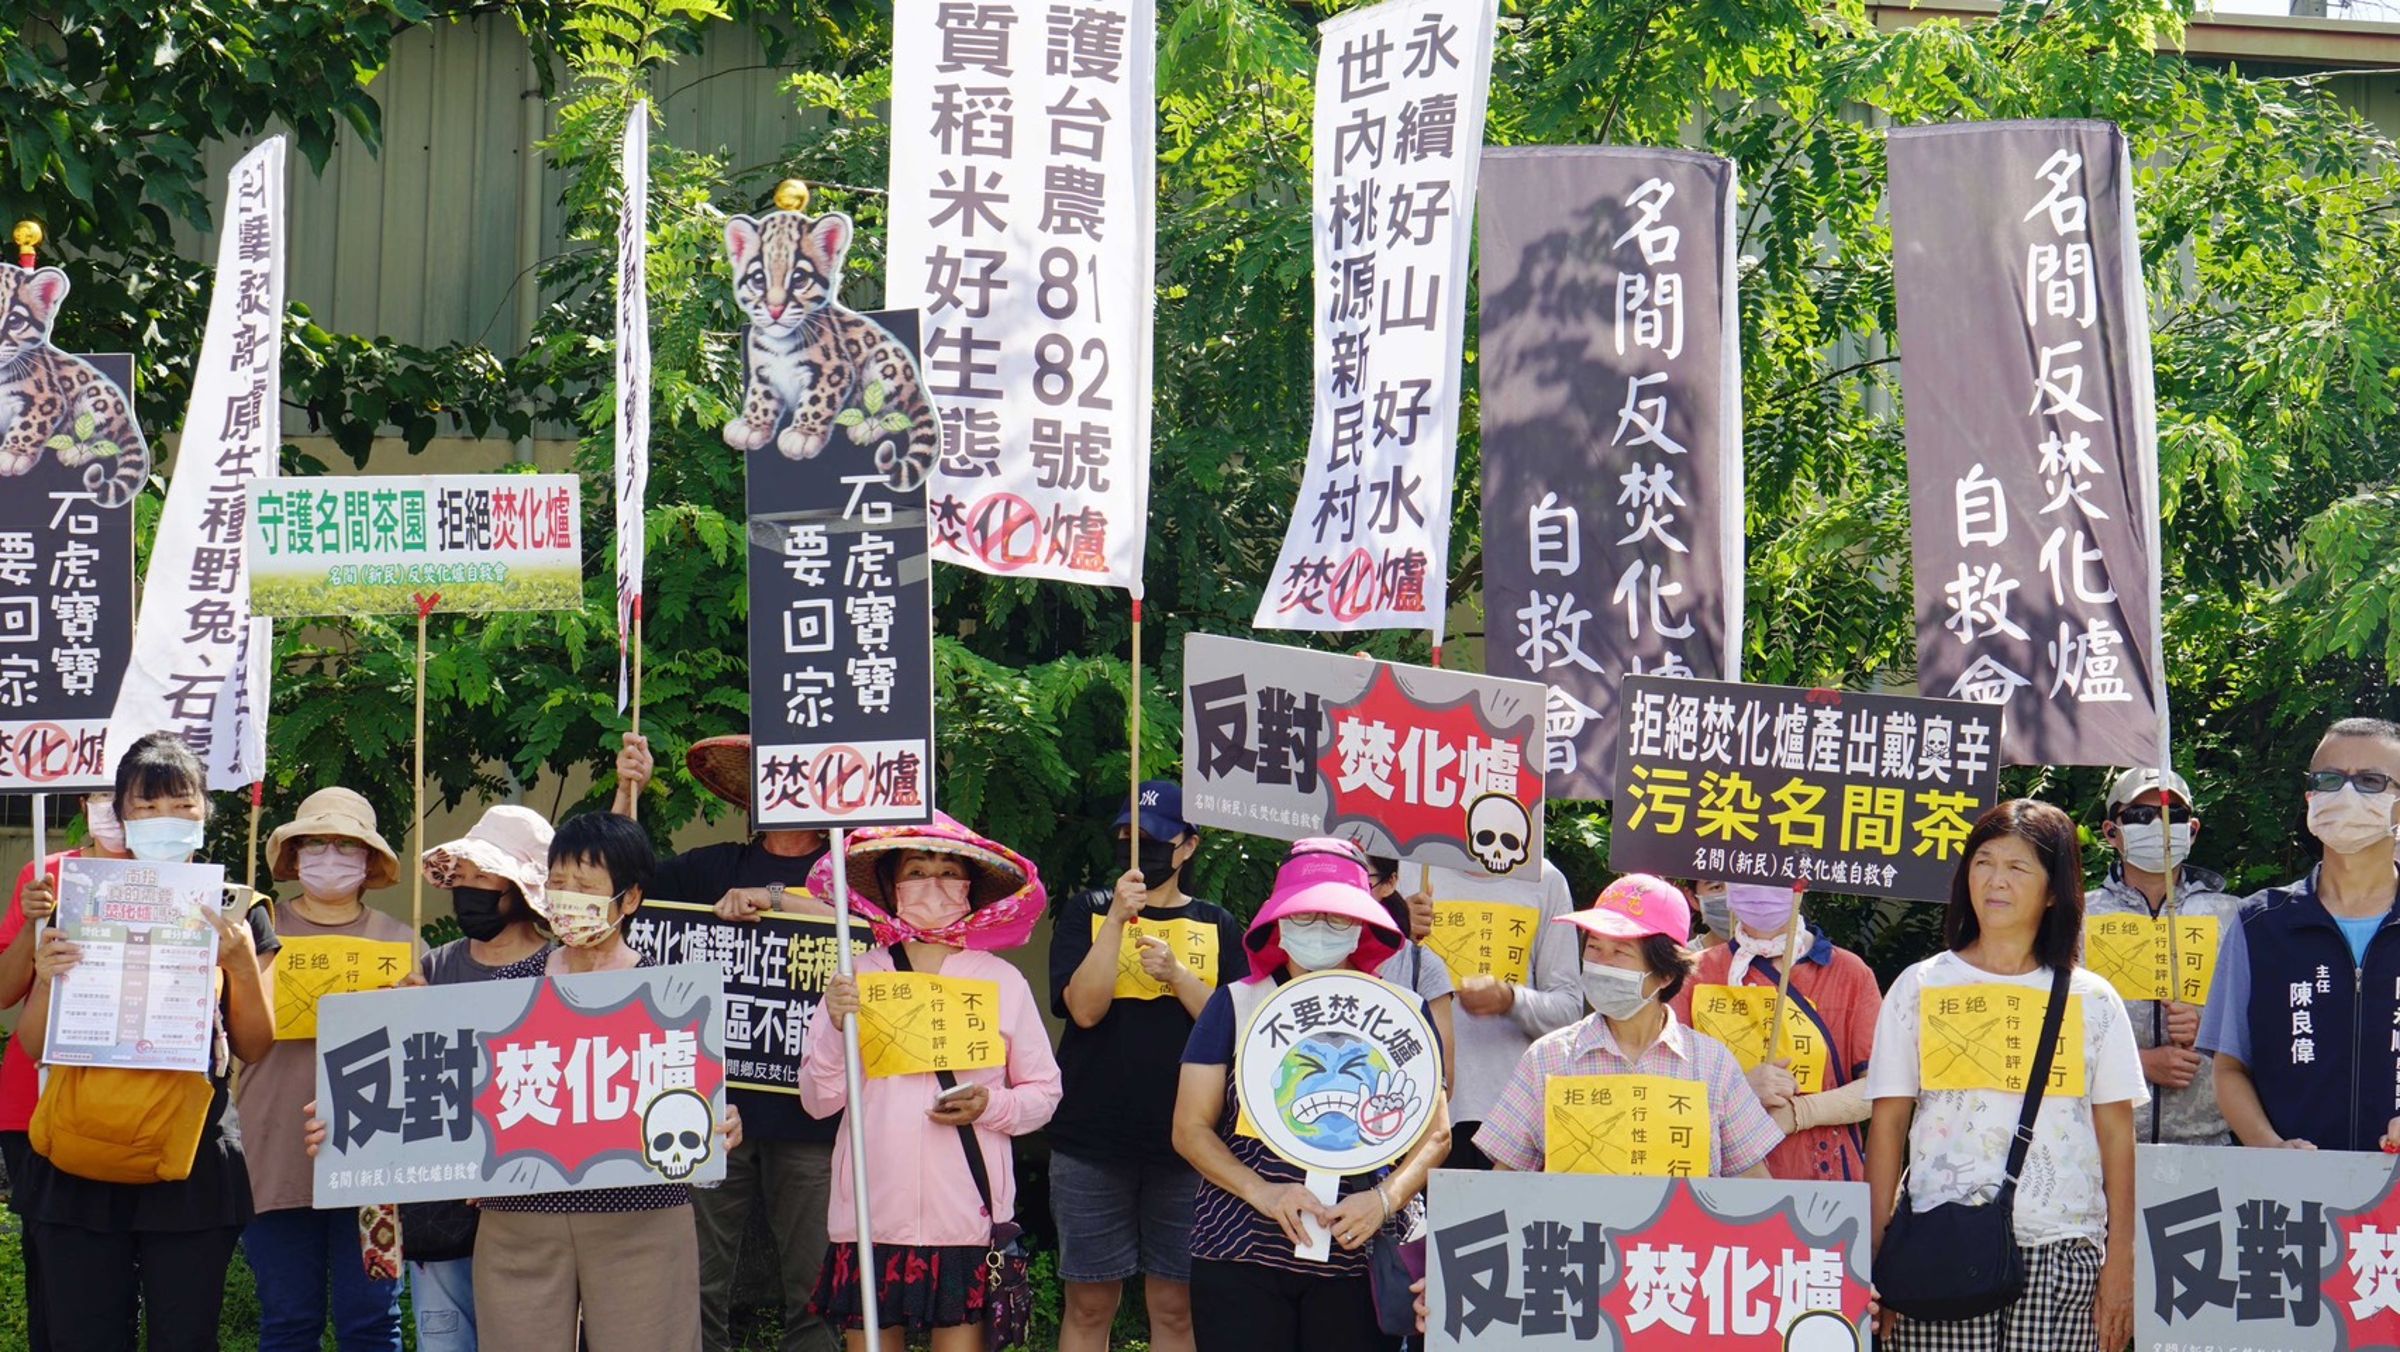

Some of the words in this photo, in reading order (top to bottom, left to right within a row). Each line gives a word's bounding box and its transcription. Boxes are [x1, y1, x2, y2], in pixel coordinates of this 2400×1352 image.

[924, 1, 1019, 480] 質稻米好生態
[1027, 6, 1127, 494] 護台農8182號
[1311, 28, 1395, 543] 世內桃源新民村
[1611, 177, 1697, 681] 名間反焚化
[2023, 148, 2133, 703] 名間反焚化爐
[257, 489, 428, 556] 守護名間茶園
[437, 485, 572, 551] 拒絕焚化爐
[929, 493, 1111, 574] 焚化爐
[48, 491, 102, 696] 石虎寶寶
[783, 523, 836, 728] 要回家
[840, 474, 898, 714] 石虎寶寶
[1276, 547, 1428, 616] 焚化爐
[1515, 490, 1605, 776] 自救會
[760, 750, 922, 811] 焚化爐
[1189, 673, 1323, 794] 反對
[1337, 715, 1521, 814] 焚化爐
[1626, 763, 1981, 862] 污染名間茶
[1692, 847, 1899, 888] 名間(新民)反焚化爐自救會
[345, 951, 360, 992] 可行
[1187, 930, 1207, 982] 不可
[2154, 922, 2168, 998] 可行性評估
[2183, 926, 2204, 998] 不可行
[2315, 964, 2331, 994] 主任
[929, 981, 949, 1069] 可行性評估
[961, 992, 991, 1062] 不可行
[1258, 993, 1423, 1069] 不要焚化爐
[2005, 995, 2022, 1089] 可行性評估
[2289, 980, 2316, 1064] 陳良偉
[323, 1025, 480, 1156] 反對
[495, 1029, 698, 1131] 焚化爐
[1630, 1085, 1648, 1175] 可行性評
[1667, 1094, 1694, 1177] 不可行
[1434, 1209, 1607, 1343] 反對
[1623, 1242, 1844, 1337] 焚化爐
[2143, 1186, 2327, 1328] 反對
